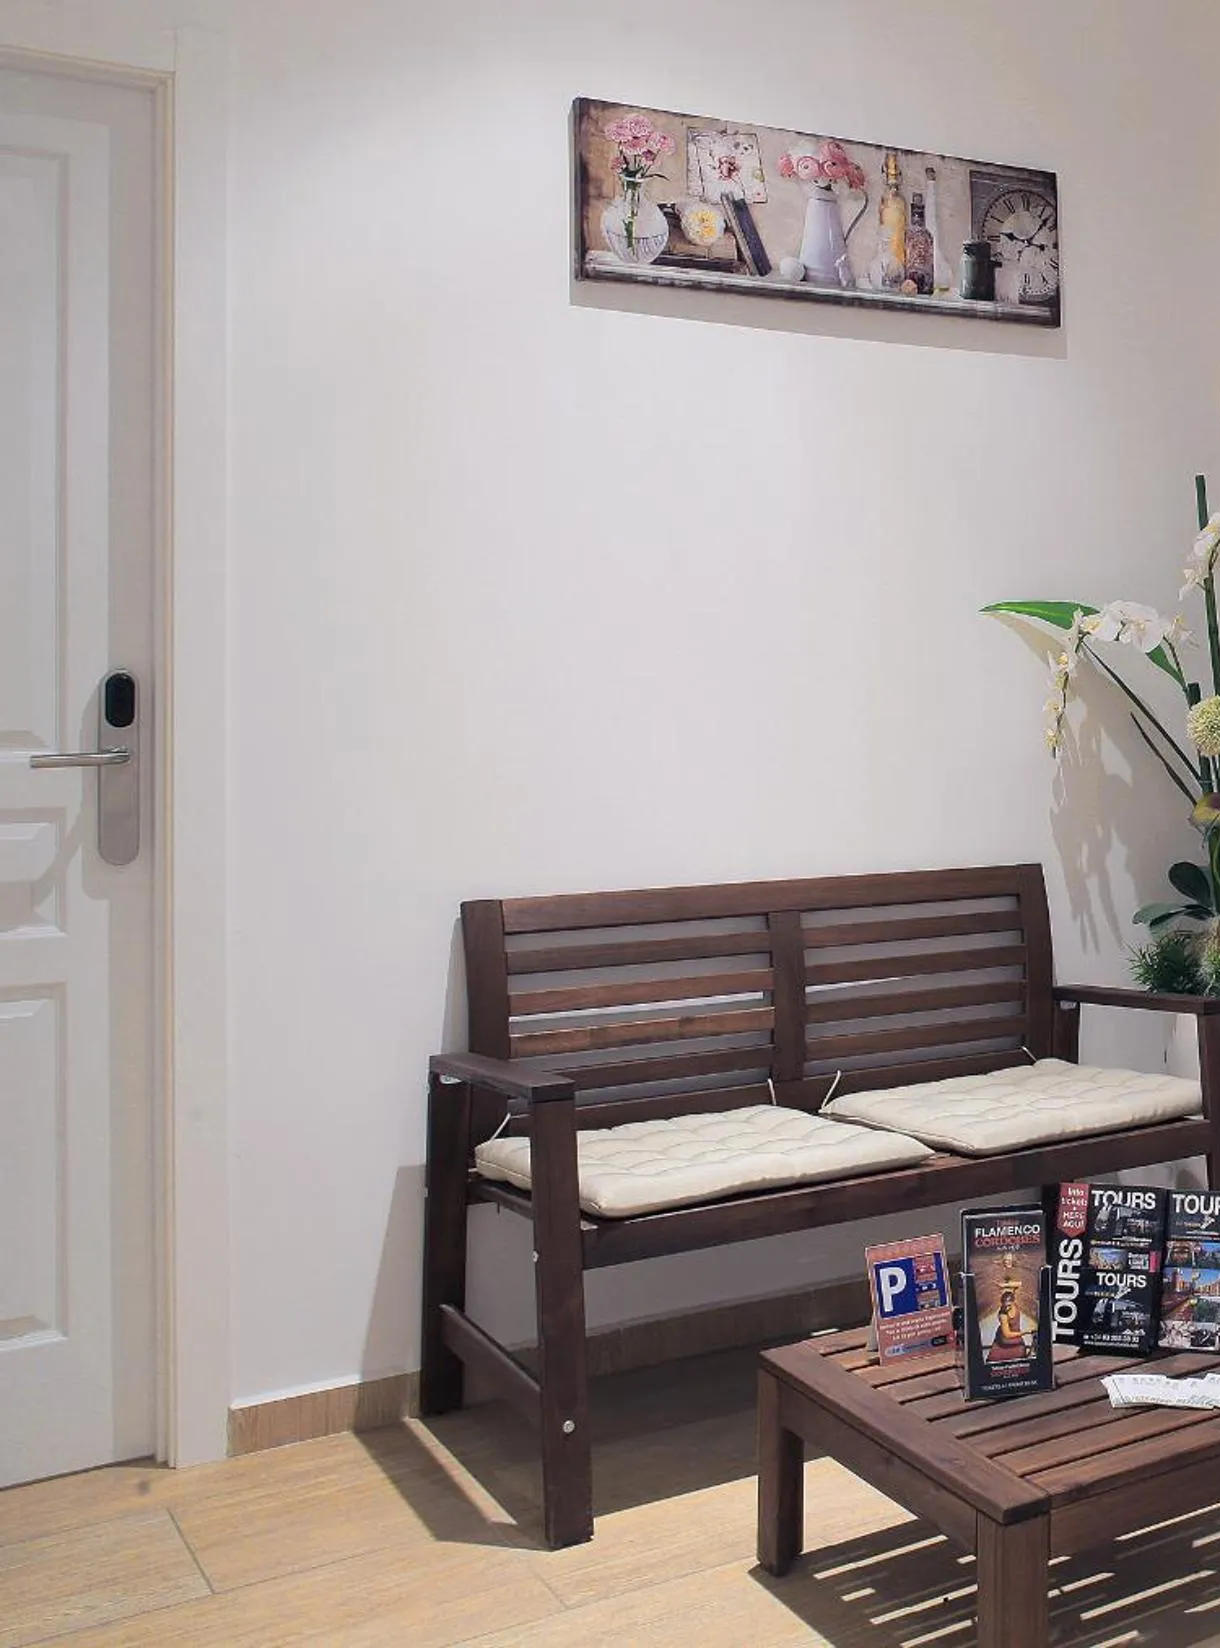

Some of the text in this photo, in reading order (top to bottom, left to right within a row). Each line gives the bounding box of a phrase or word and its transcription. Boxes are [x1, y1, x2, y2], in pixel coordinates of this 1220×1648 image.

[1091, 1190, 1156, 1210] TOURS
[975, 1224, 1040, 1238] FLAMENCO
[880, 1267, 907, 1313] P
[1052, 1238, 1083, 1342] TOURS
[1096, 1272, 1147, 1288] TOURS
